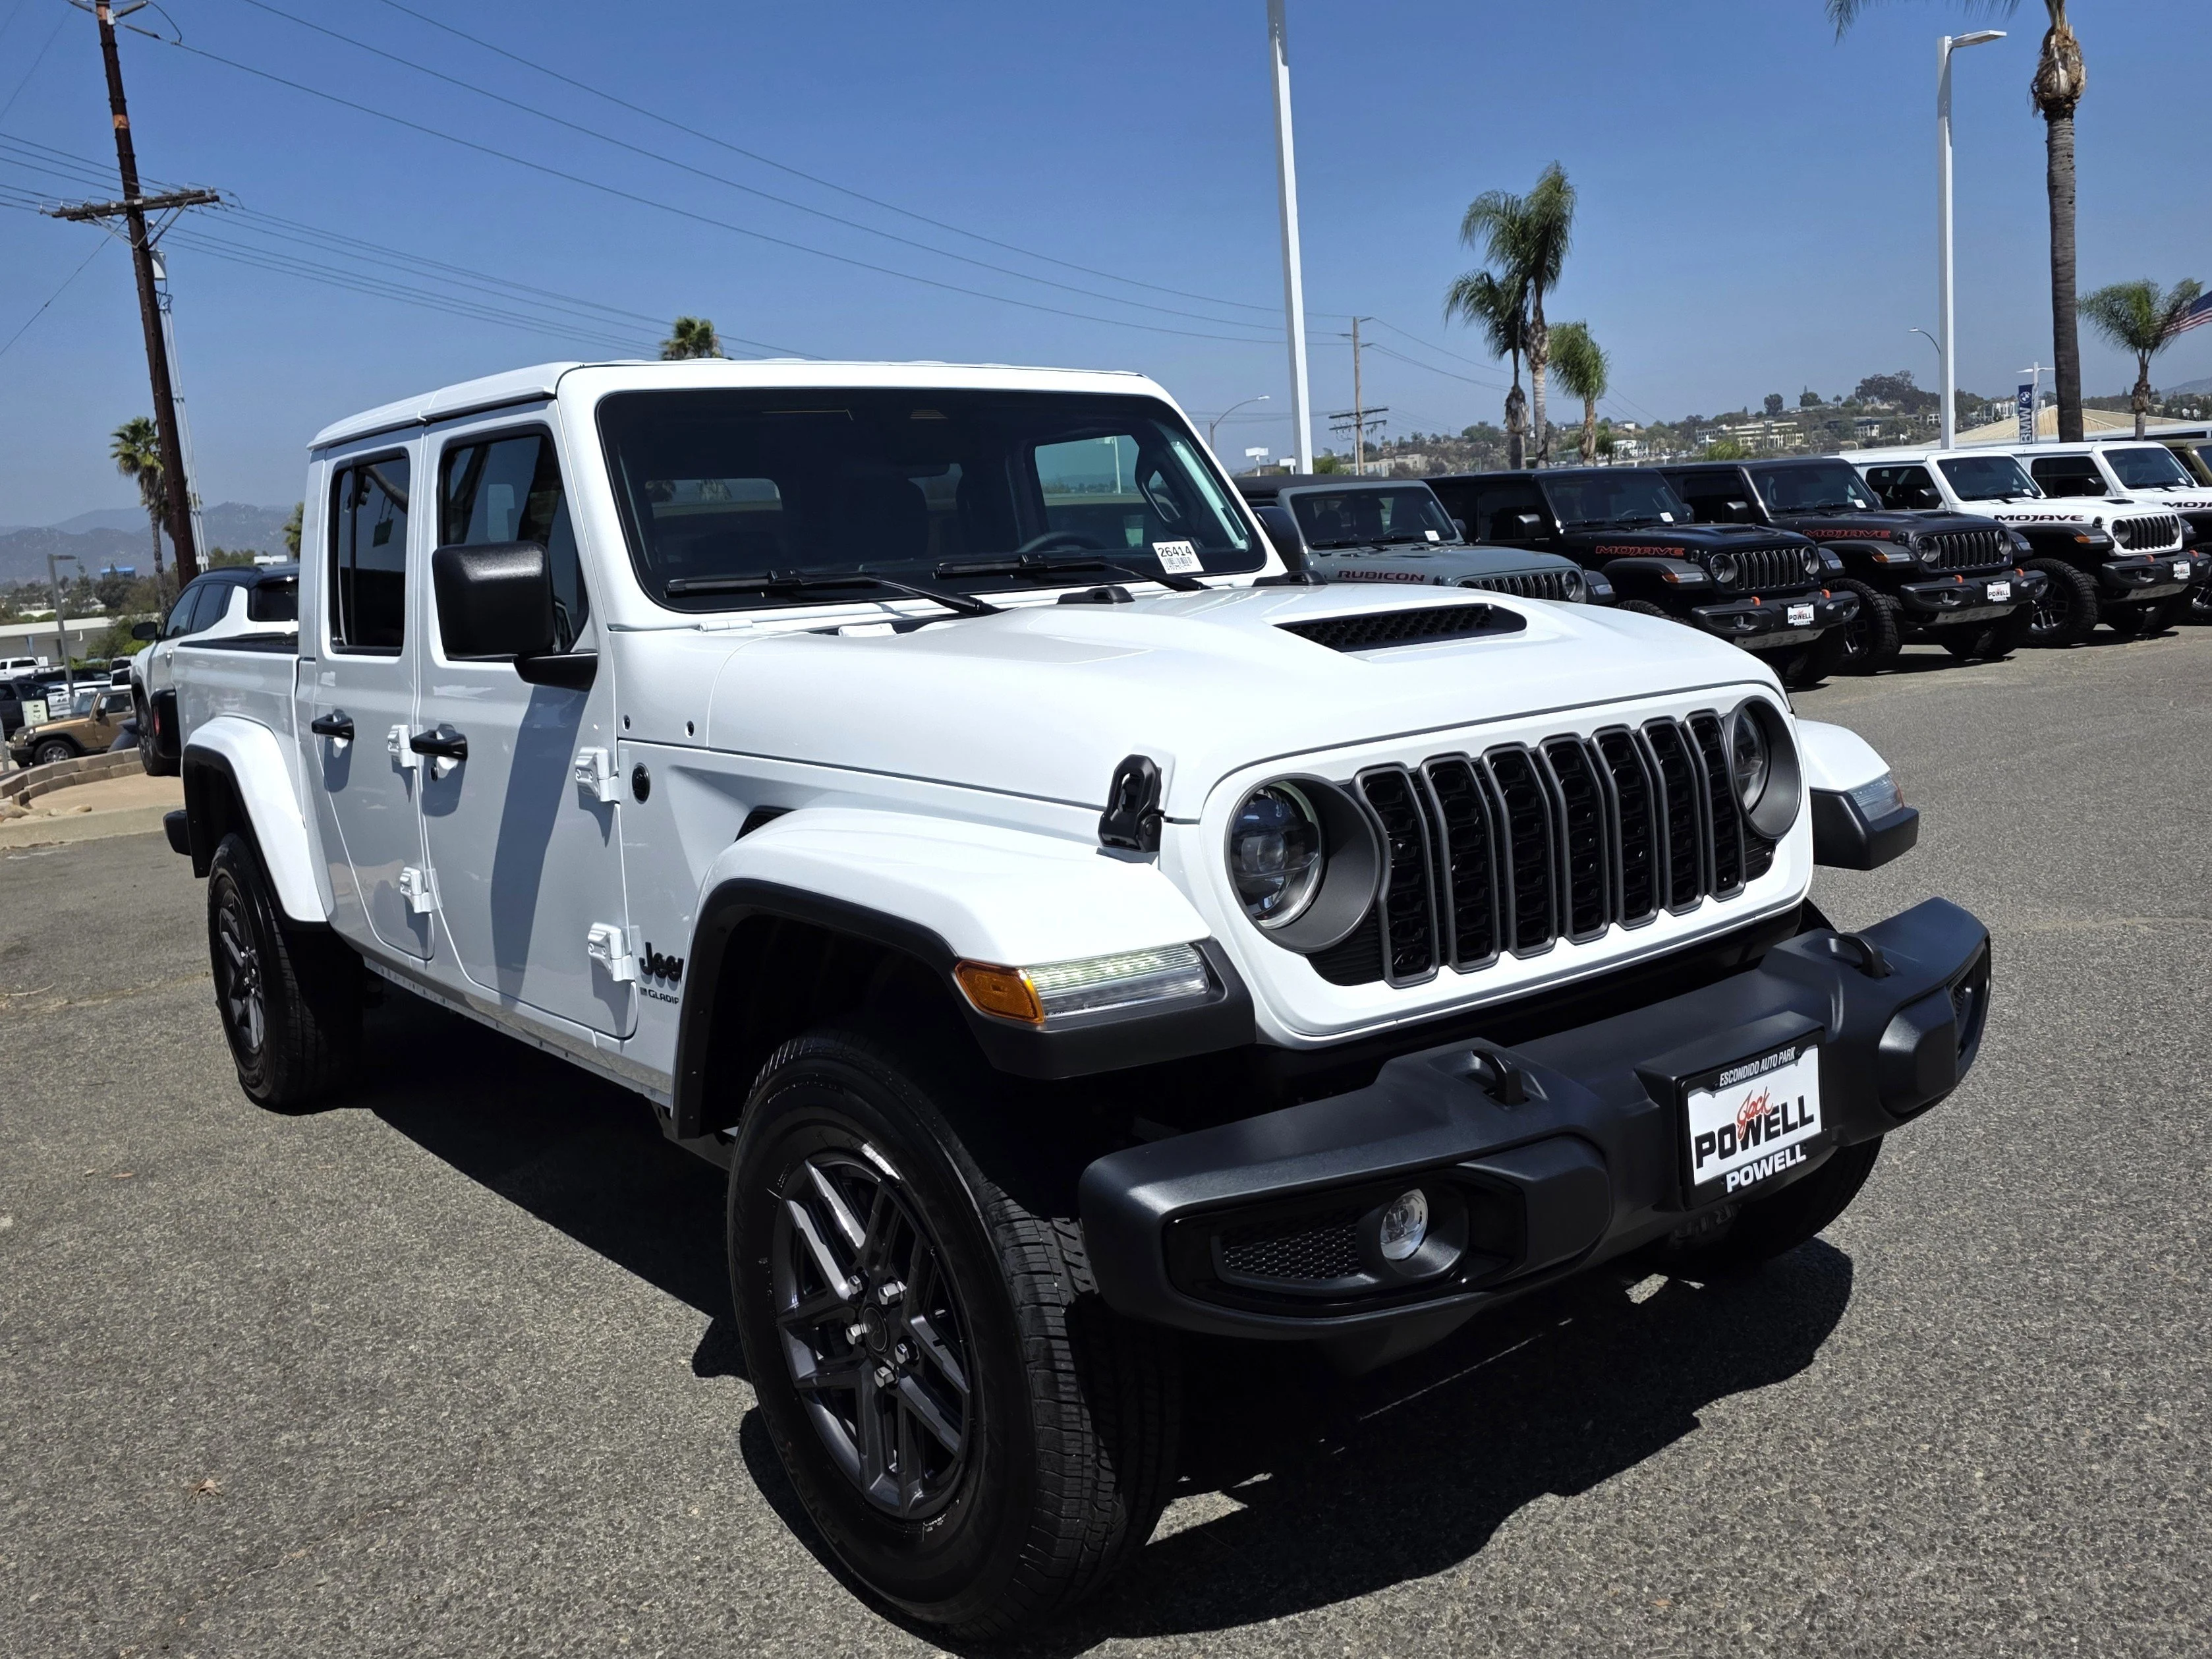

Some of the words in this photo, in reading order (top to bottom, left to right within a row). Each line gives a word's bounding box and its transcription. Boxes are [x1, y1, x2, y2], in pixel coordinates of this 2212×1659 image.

[2020, 407, 2031, 444] BMW
[1158, 546, 1193, 557] 26414
[1595, 546, 1685, 556] MOJAVE
[1803, 529, 1891, 538] MOJAVE
[1338, 570, 1425, 582] RUBICON
[1719, 1061, 1759, 1088] ESCONDIDO
[1759, 1054, 1778, 1072] AUTO
[1778, 1047, 1796, 1065] PARK
[1737, 1086, 1774, 1140] Jack
[1694, 1095, 1815, 1170] POWELL
[1726, 1144, 1807, 1194] POWELL
